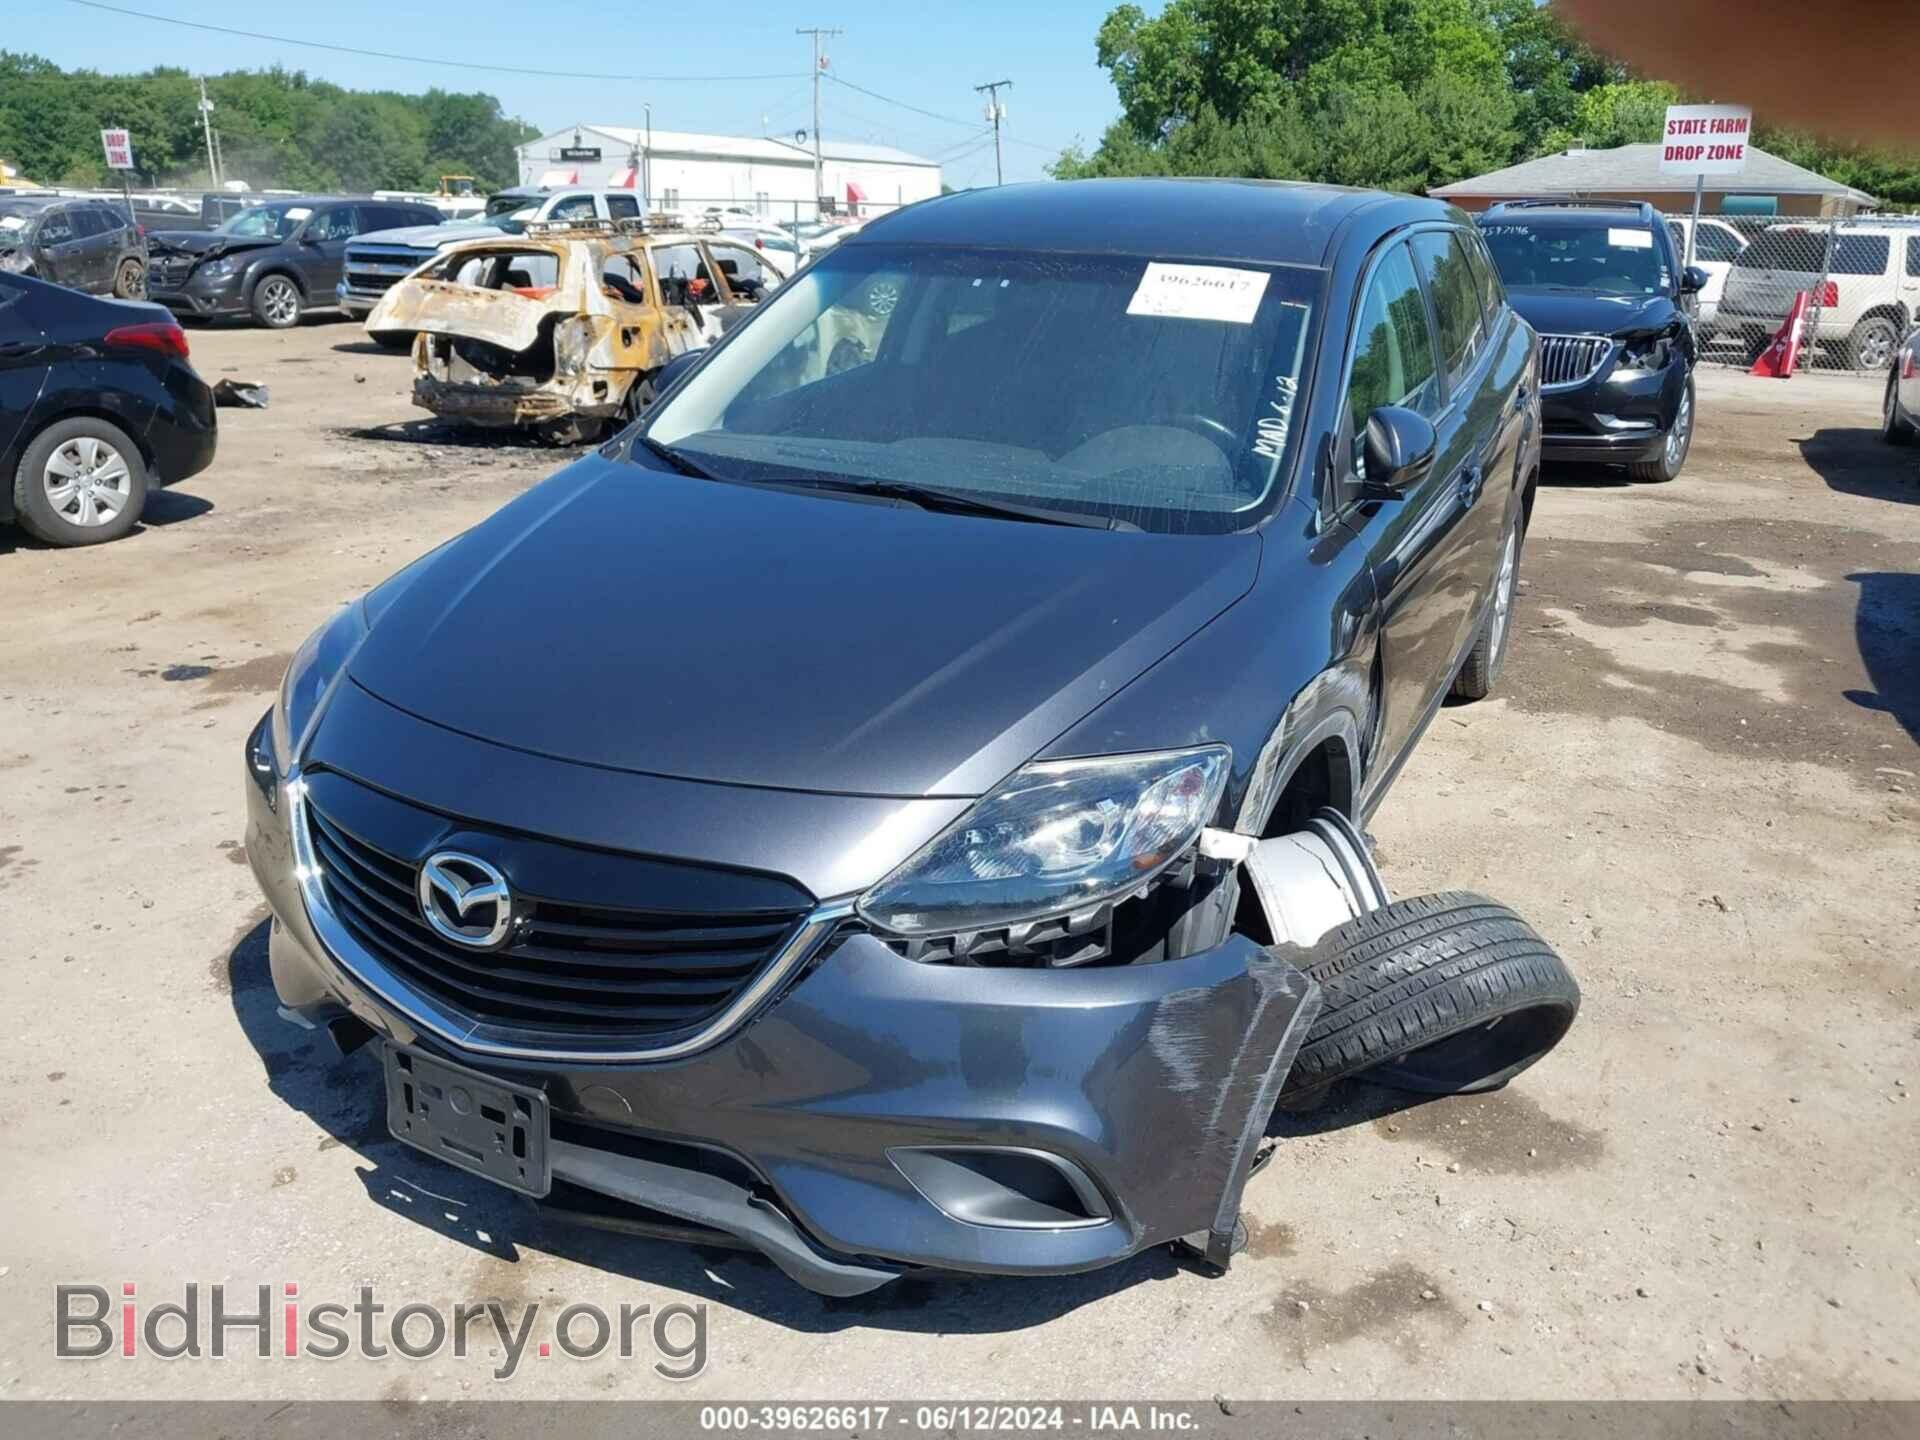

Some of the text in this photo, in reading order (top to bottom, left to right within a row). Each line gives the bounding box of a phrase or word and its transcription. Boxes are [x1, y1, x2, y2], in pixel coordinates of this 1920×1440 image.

[1668, 118, 1747, 135] STATE FARM
[1664, 145, 1744, 160] DROP ZONE
[1251, 417, 1289, 460] MAD
